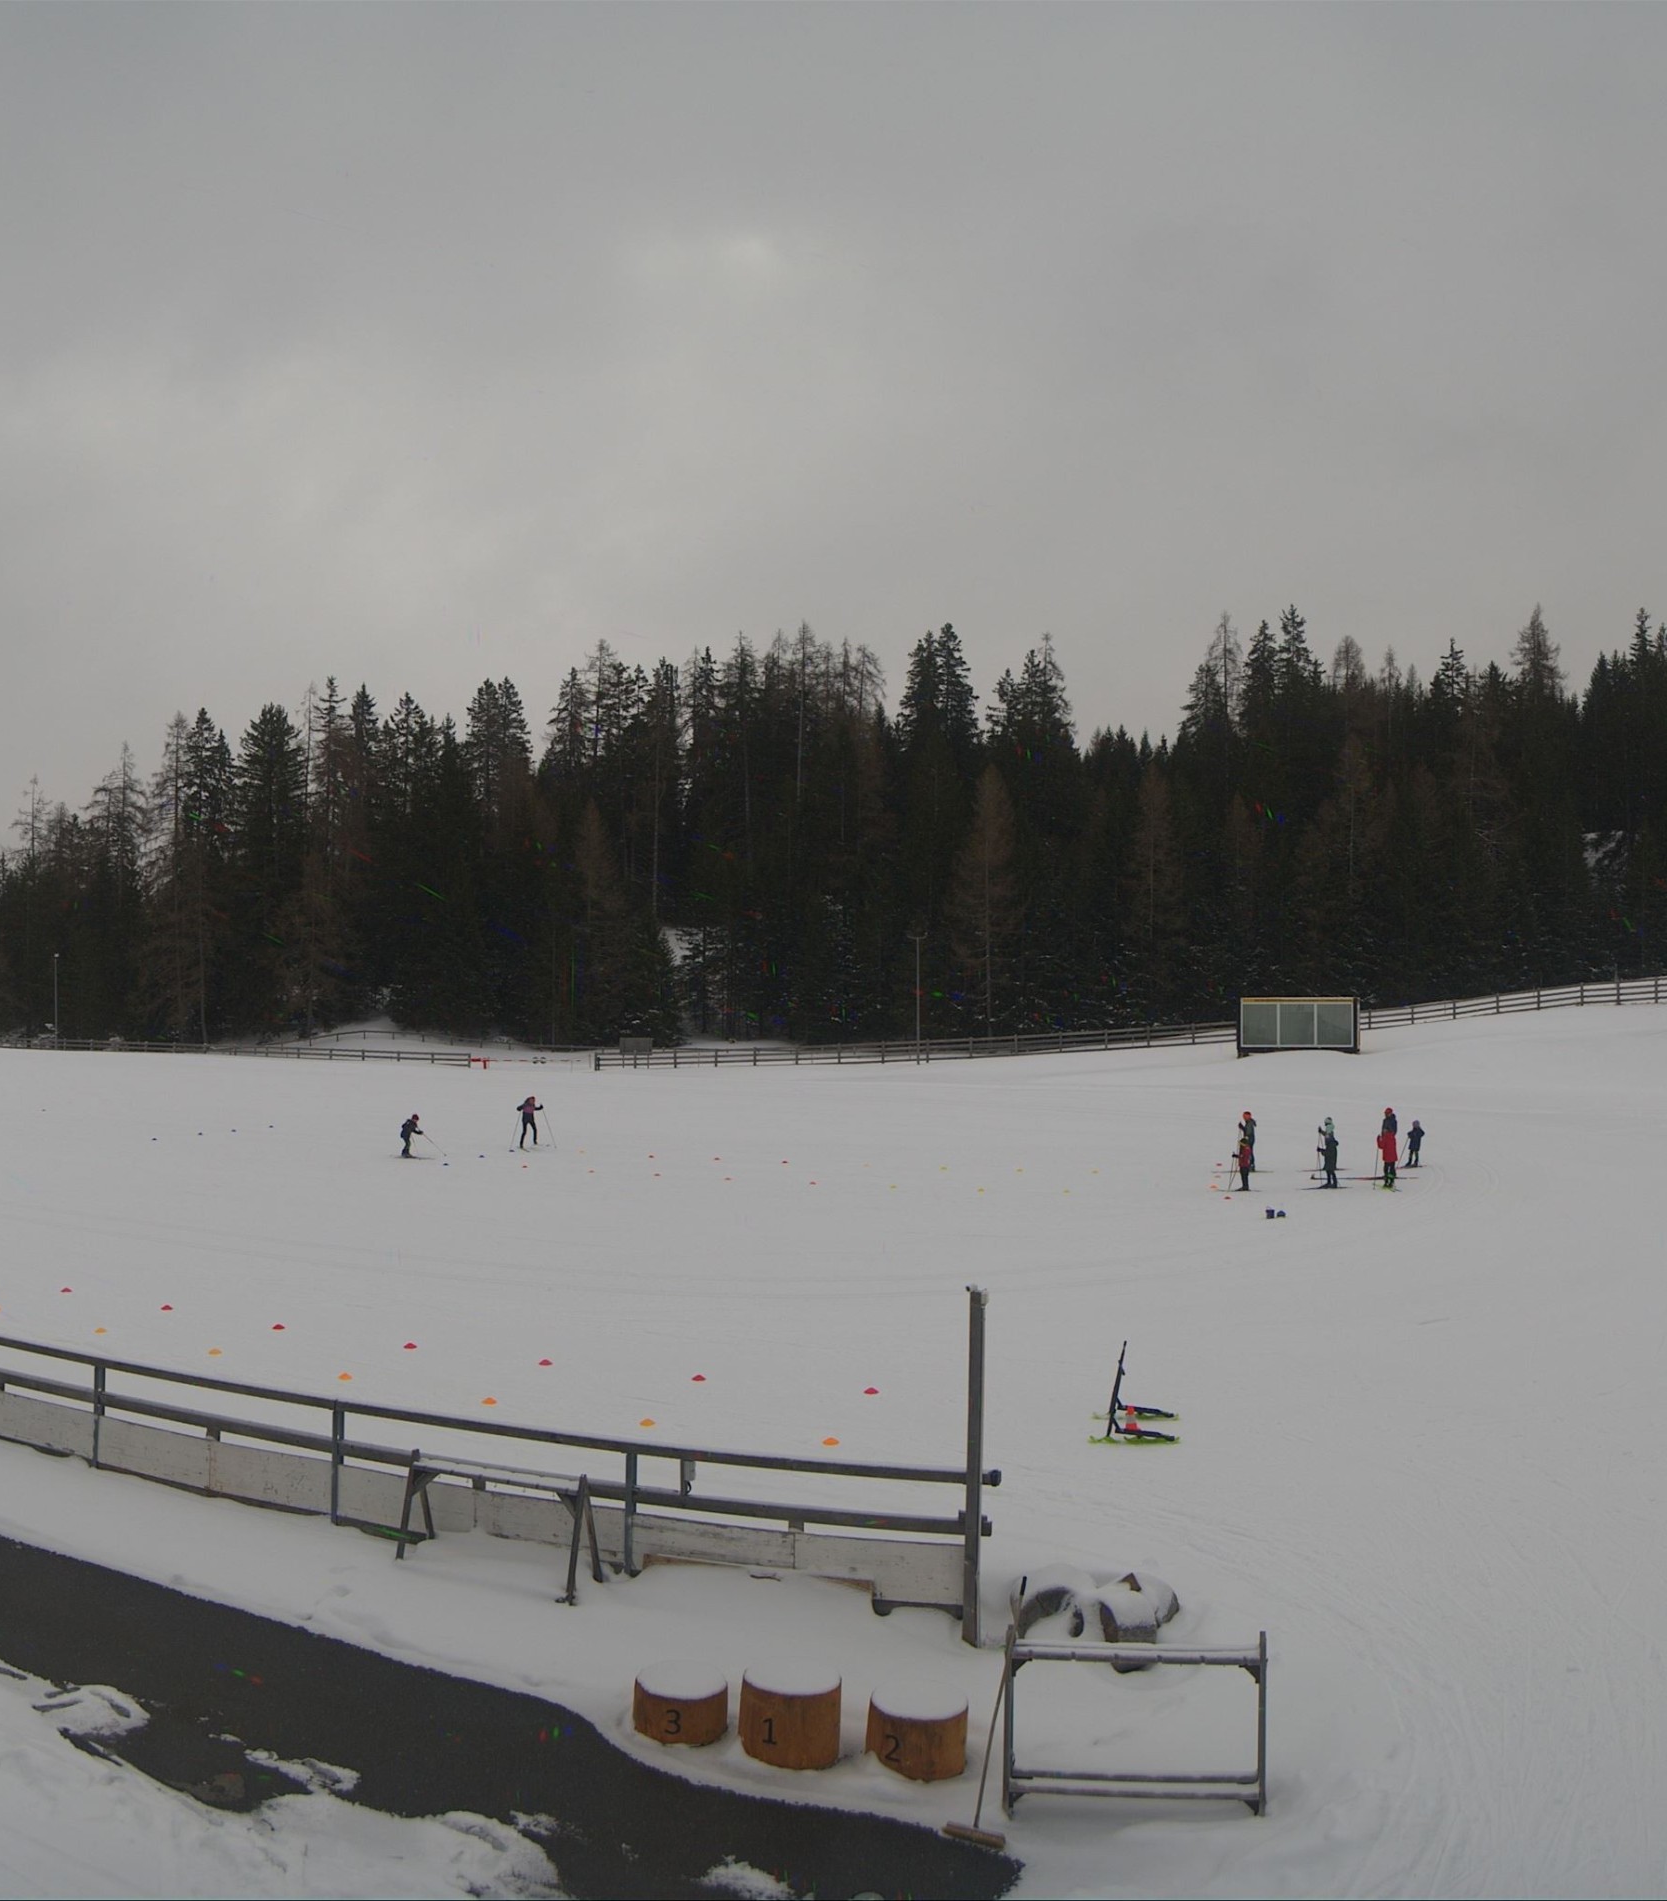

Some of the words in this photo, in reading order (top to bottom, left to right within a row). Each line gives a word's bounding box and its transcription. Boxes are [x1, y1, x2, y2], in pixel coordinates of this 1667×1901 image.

[663, 1709, 683, 1735] 3
[761, 1718, 777, 1746] 1
[881, 1734, 905, 1760] 2
